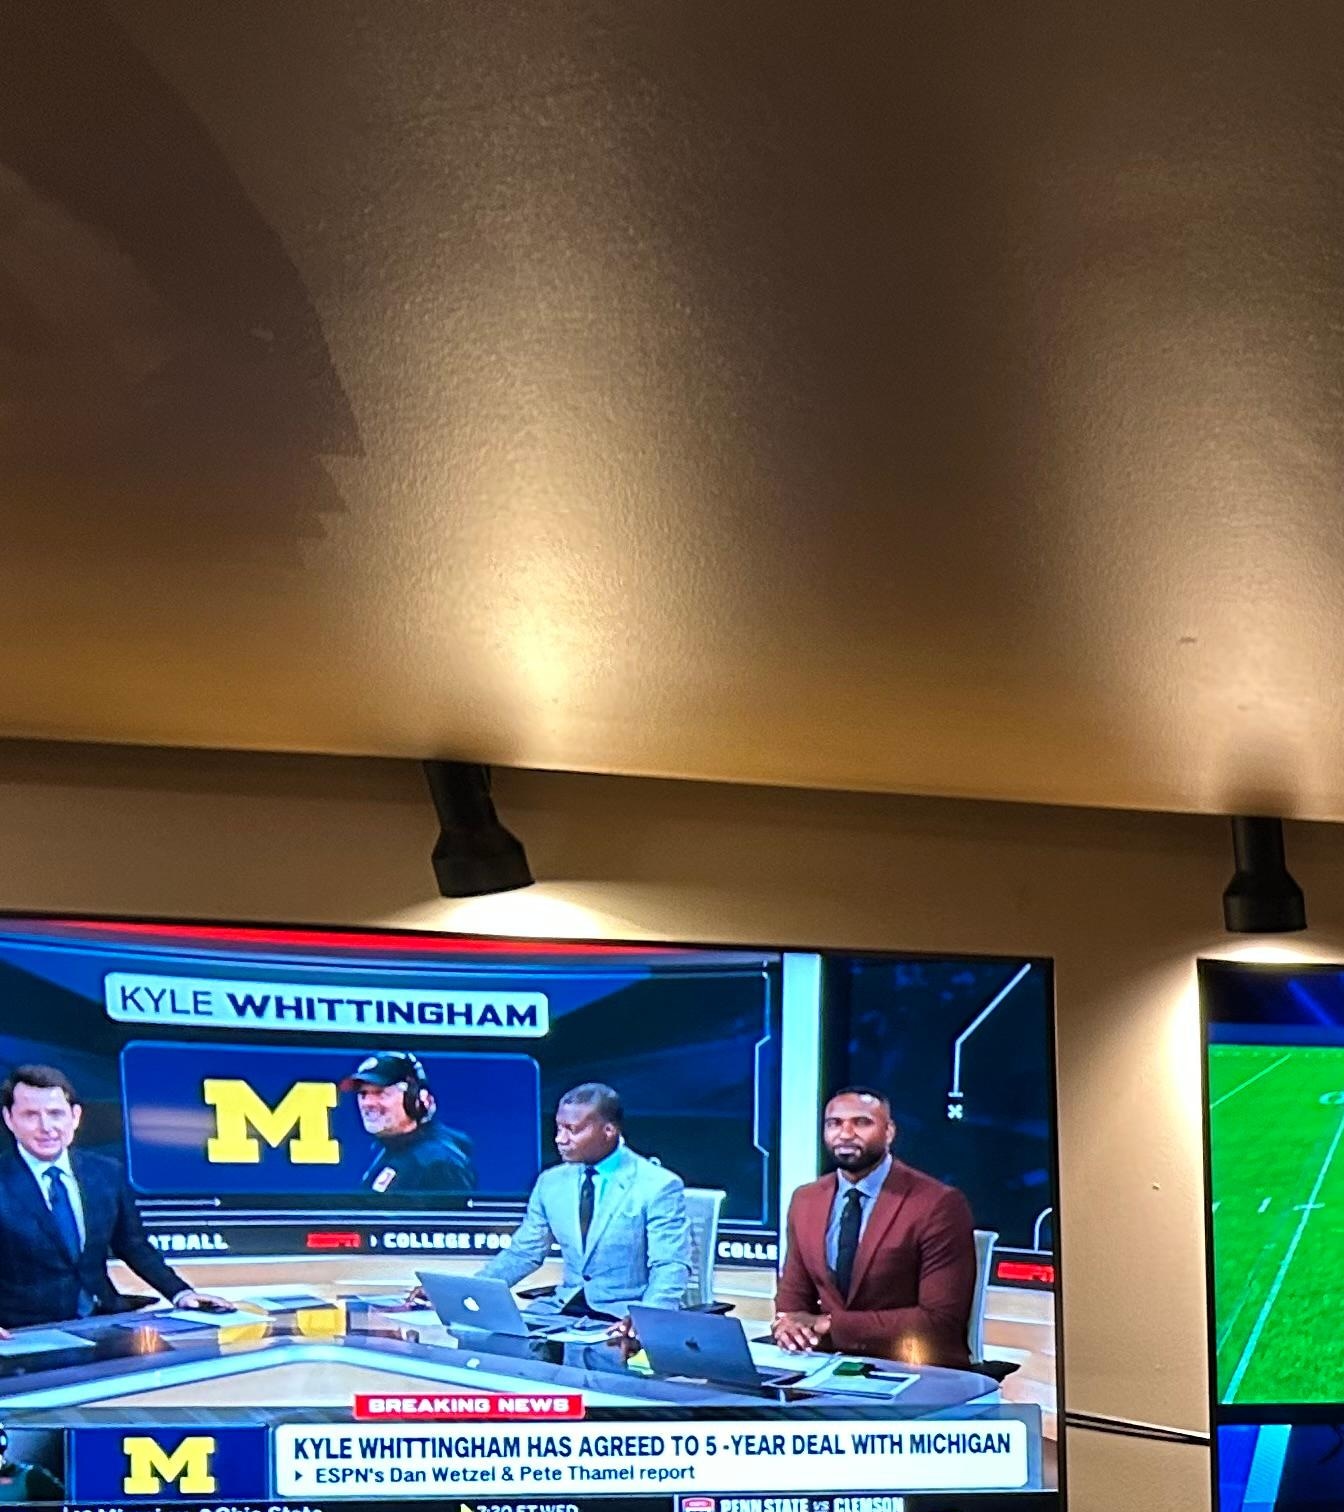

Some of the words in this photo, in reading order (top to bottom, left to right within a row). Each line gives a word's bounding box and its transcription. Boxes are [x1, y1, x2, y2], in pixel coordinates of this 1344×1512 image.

[120, 986, 214, 1017] KYLE
[226, 993, 538, 1028] WHITTINGHAM
[203, 1078, 341, 1164] M
[369, 1398, 489, 1413] BREAKING
[499, 1399, 568, 1413] NEWS
[294, 1437, 351, 1459] KYLE
[359, 1437, 521, 1459] WHITTINGHAM
[528, 1436, 572, 1457] HAS
[579, 1435, 665, 1457] AGREED
[671, 1435, 700, 1457] TO
[793, 1434, 846, 1455] DEAL
[852, 1433, 903, 1454] WITH
[909, 1432, 1010, 1454] MICHIGAN
[123, 1436, 217, 1495] M
[390, 1467, 426, 1483] Dan
[432, 1466, 496, 1482] Wetzel
[502, 1467, 513, 1482] &
[519, 1466, 562, 1482] Pete
[568, 1465, 635, 1481] Thamel
[640, 1465, 695, 1483] report
